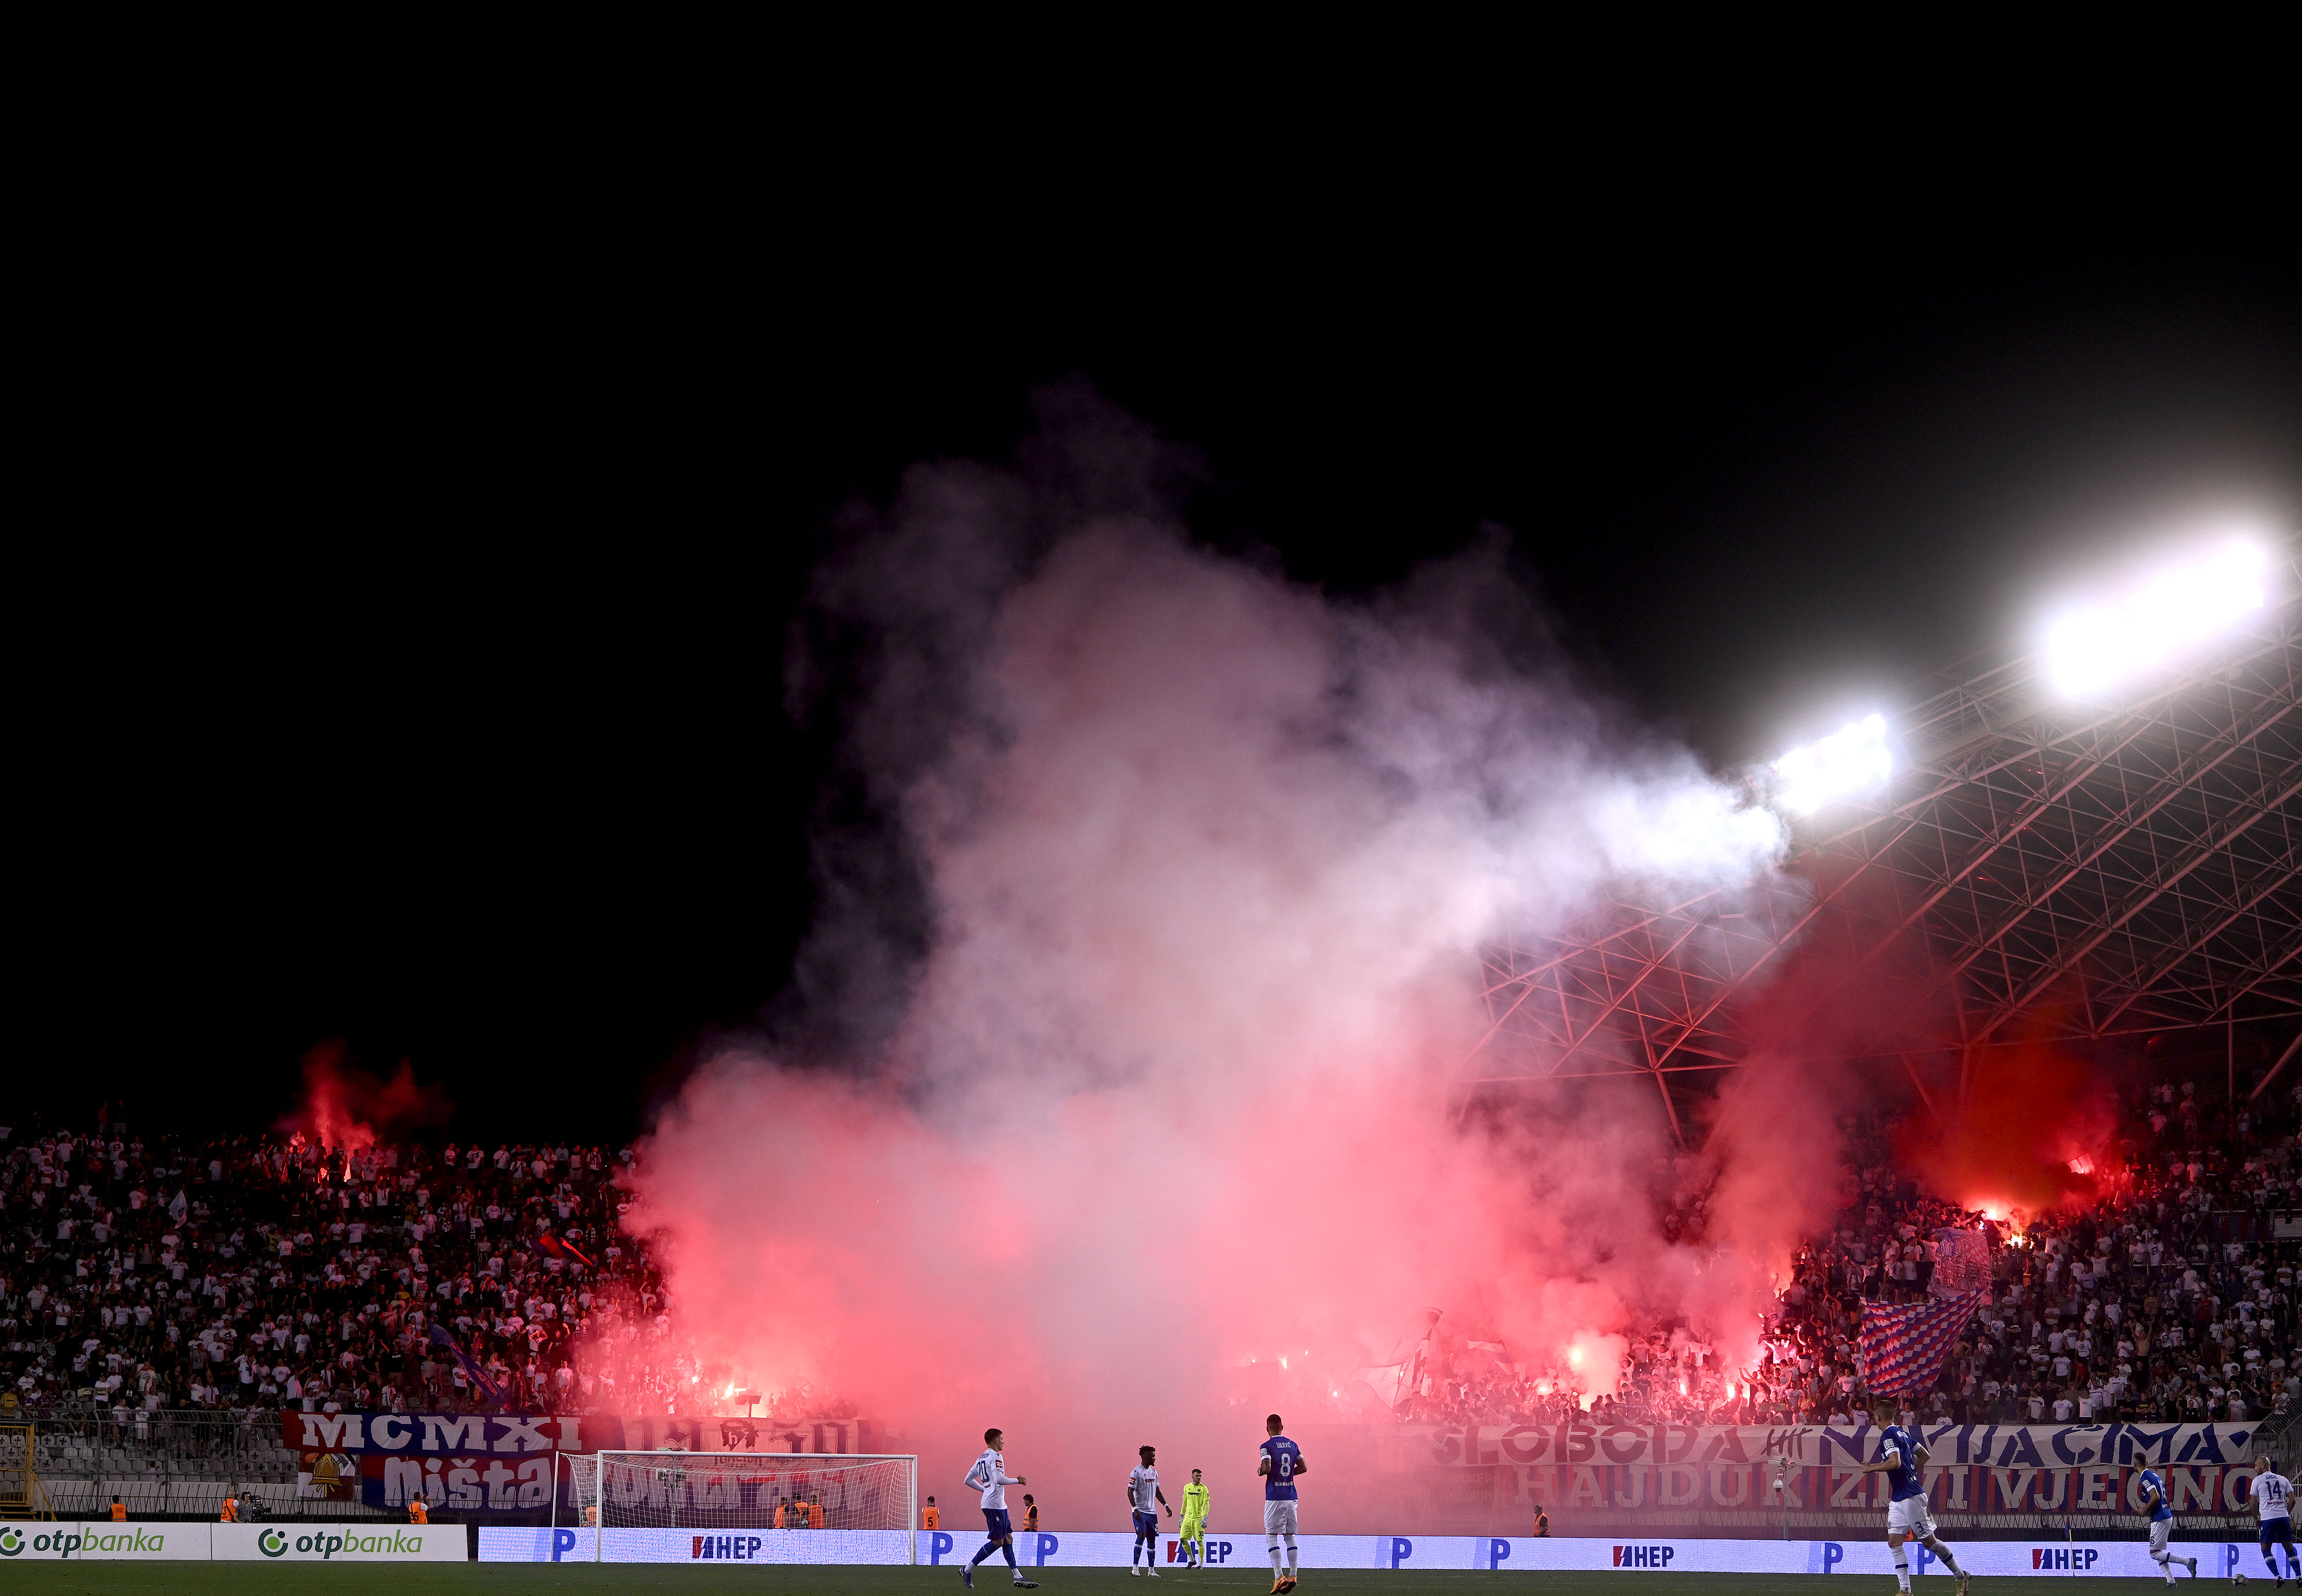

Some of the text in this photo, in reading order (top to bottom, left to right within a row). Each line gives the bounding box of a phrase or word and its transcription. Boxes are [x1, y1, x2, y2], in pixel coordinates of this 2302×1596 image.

[299, 1414, 582, 1452] MCMXI
[1431, 1425, 1749, 1464] SLOBODA
[1280, 1453, 1290, 1477] 8
[1514, 1464, 1803, 1508] HAJDUK
[2265, 1480, 2282, 1500] 14
[927, 1517, 934, 1527] 5
[1915, 1521, 1924, 1532] 3
[553, 1529, 576, 1562] P
[717, 1536, 762, 1559] HEP
[932, 1532, 953, 1566] P
[1036, 1534, 1059, 1567] P
[1392, 1538, 1412, 1569] P
[1490, 1539, 1511, 1570] P
[1635, 1546, 1674, 1567] HEP
[1824, 1542, 1843, 1574] P
[2054, 1549, 2099, 1570] HEP
[2227, 1544, 2240, 1578] P
